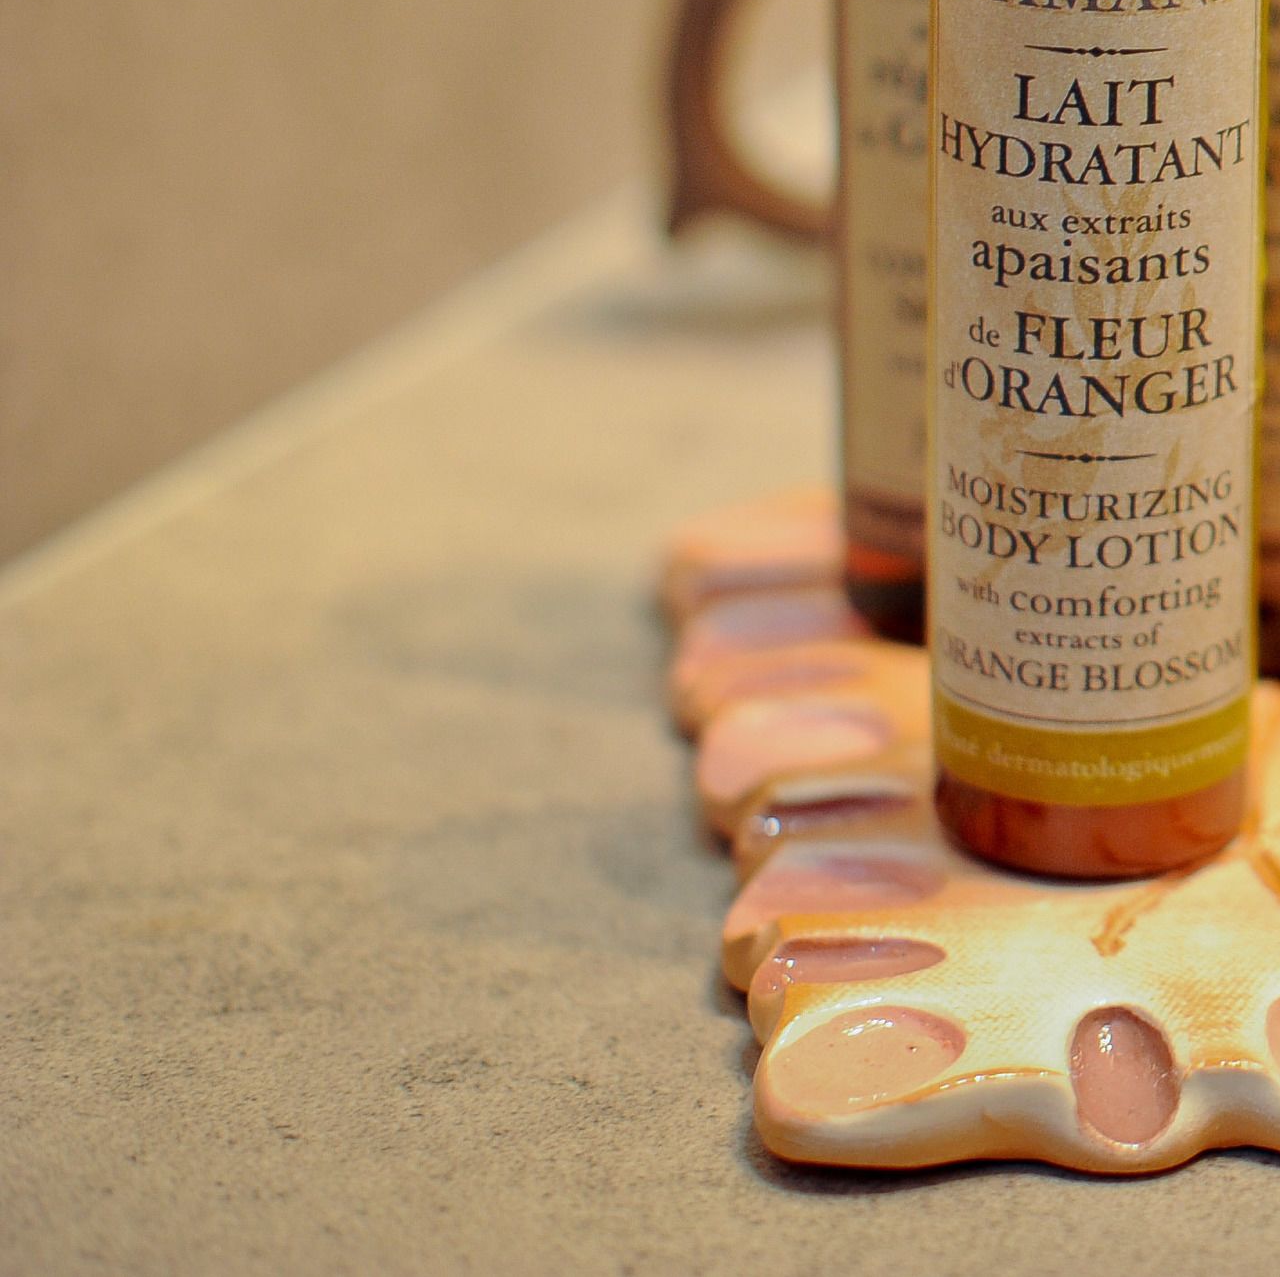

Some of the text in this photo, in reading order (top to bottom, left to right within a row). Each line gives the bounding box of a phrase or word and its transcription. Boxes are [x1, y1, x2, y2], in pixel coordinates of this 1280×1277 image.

[1013, 73, 1175, 127] LAIT
[941, 113, 1250, 185] HYDRATANT
[991, 204, 1191, 234] aux extraits
[971, 239, 1211, 288] apaisants
[969, 307, 1212, 360] de FLEUR
[944, 354, 1239, 418] d'ORANGER
[949, 463, 1232, 521] MOISTURIZING
[941, 500, 1241, 569] BODY LOTION
[957, 576, 1222, 618] with comforting
[1015, 623, 1163, 650] extracts of
[1081, 632, 1243, 692] BLOSSOM
